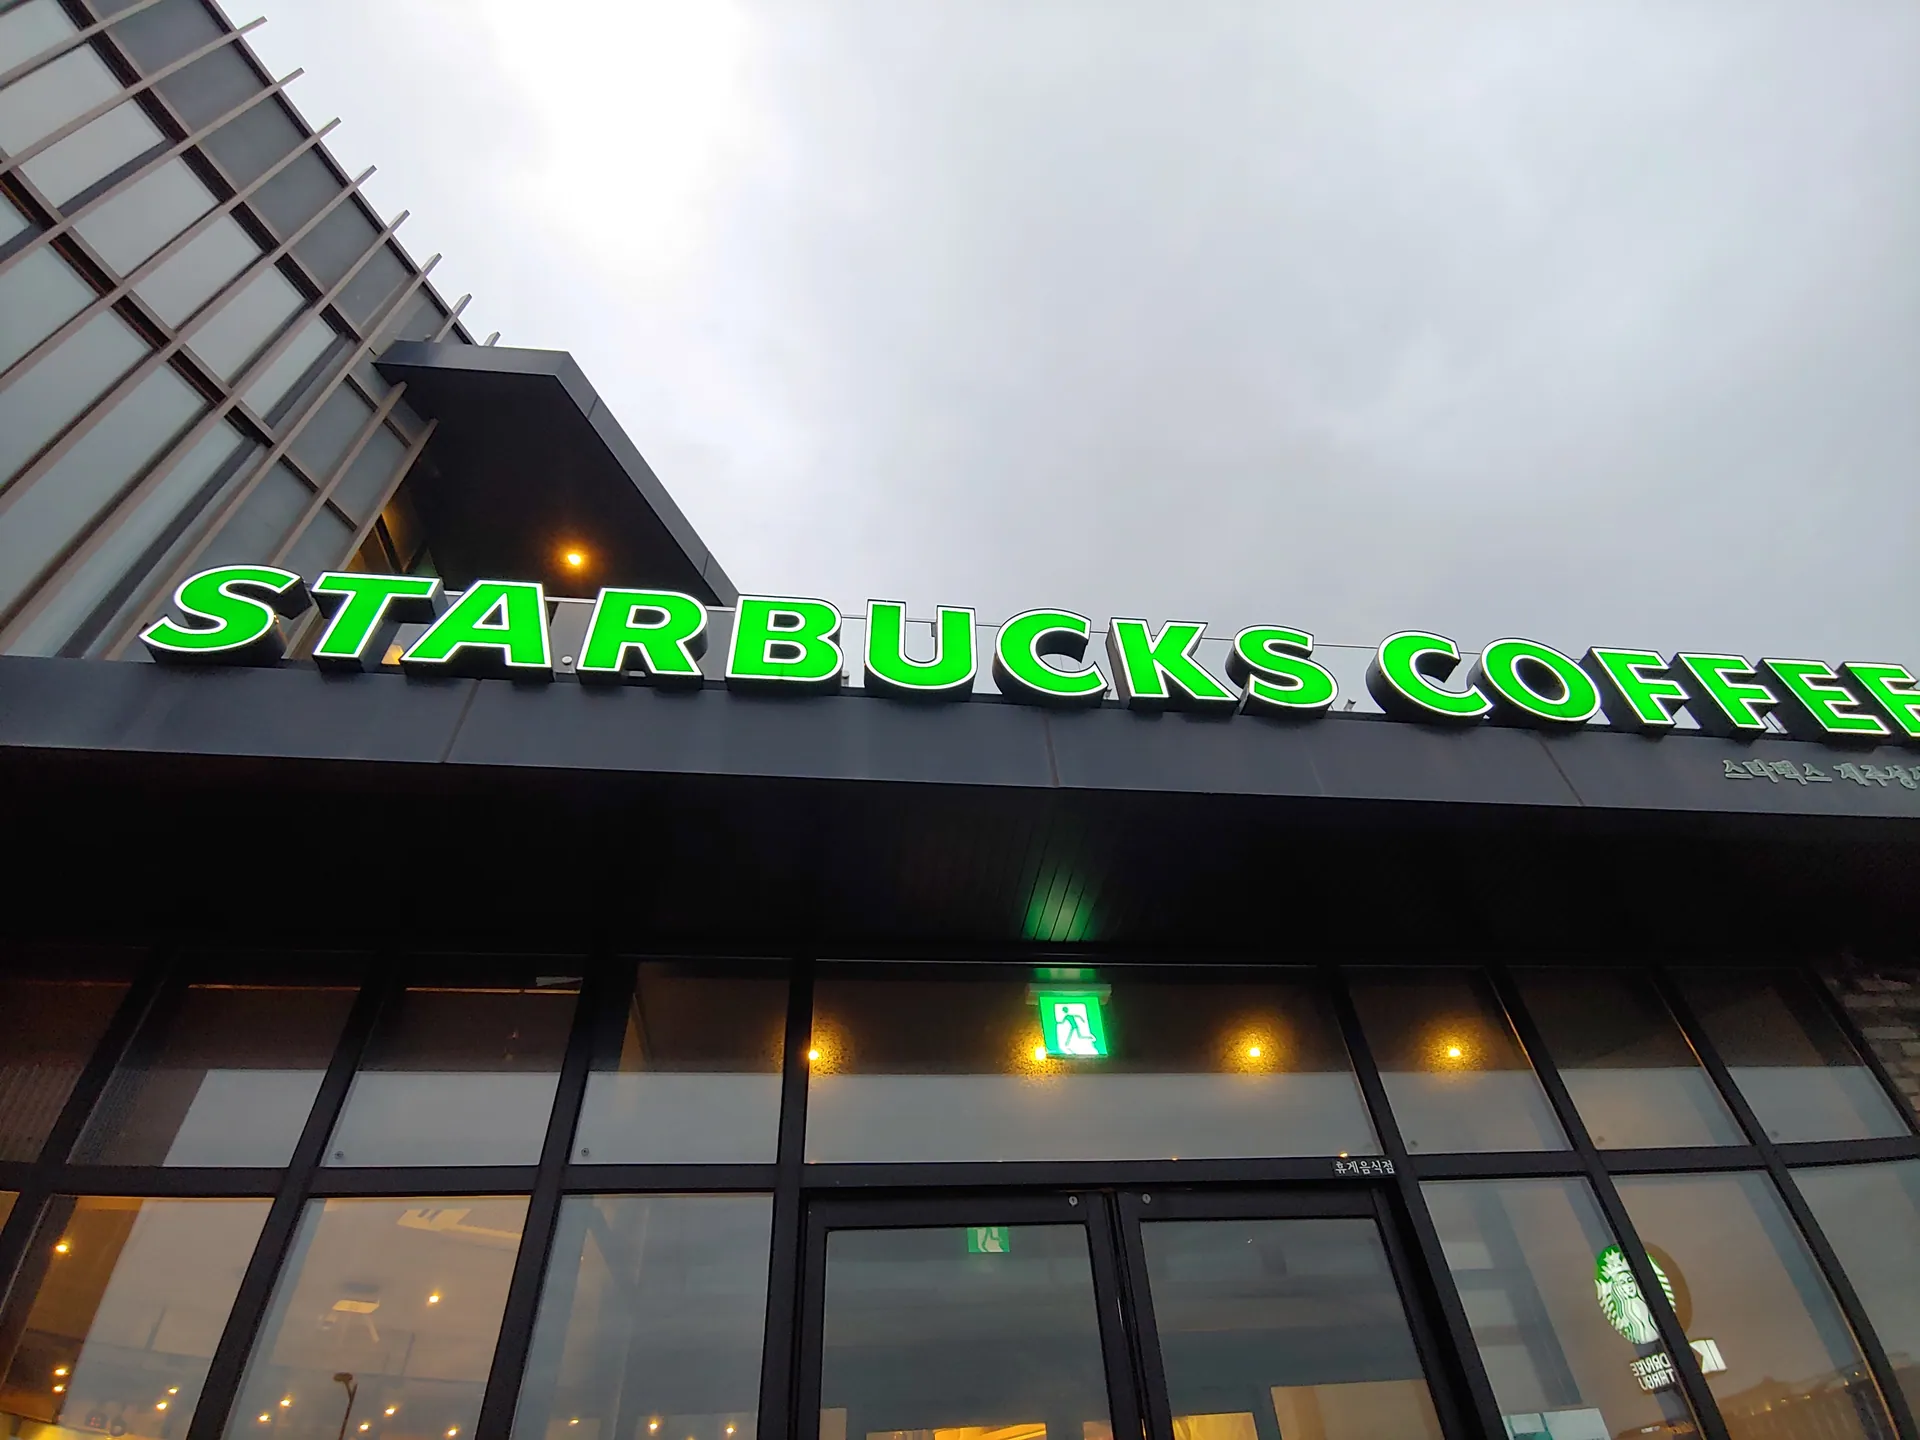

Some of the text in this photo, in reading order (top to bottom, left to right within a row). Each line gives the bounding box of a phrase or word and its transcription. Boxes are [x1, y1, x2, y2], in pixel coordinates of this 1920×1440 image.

[139, 565, 1920, 737] STARBUCKS COFFEE
[1722, 758, 1833, 786] 스타벅스
[1335, 1160, 1395, 1174] 휴게음식점
